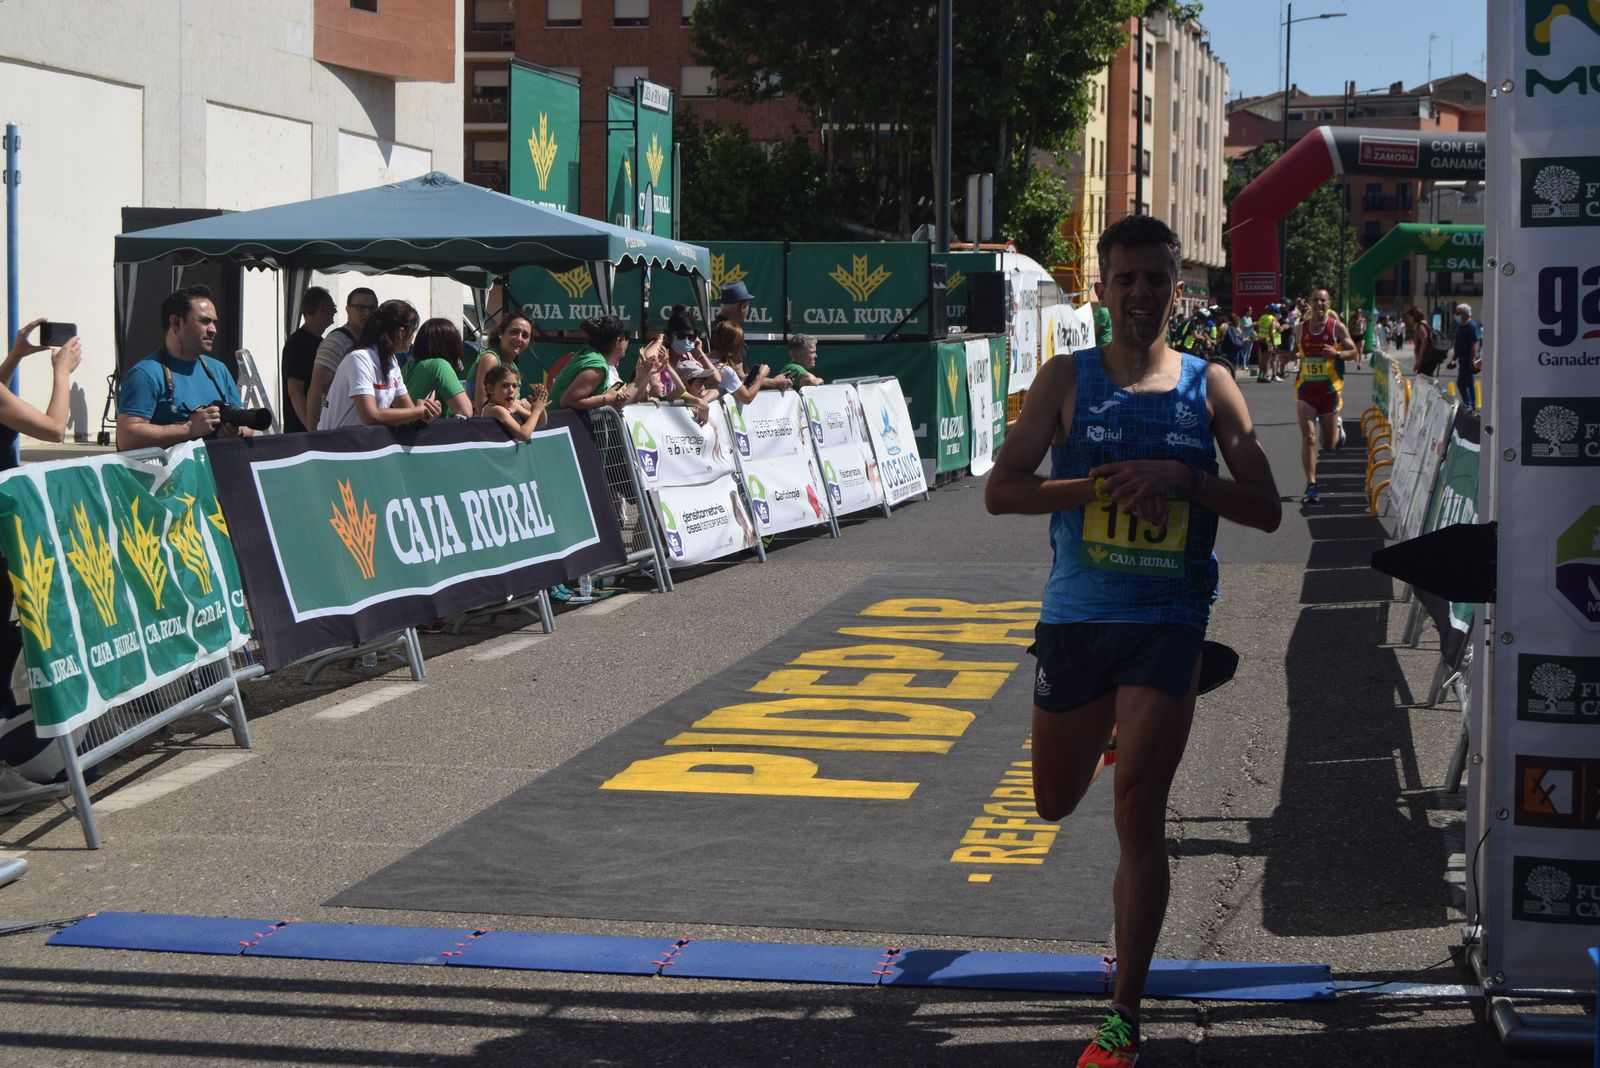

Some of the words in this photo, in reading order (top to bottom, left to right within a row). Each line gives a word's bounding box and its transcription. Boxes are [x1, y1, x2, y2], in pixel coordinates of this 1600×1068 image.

[1431, 141, 1461, 153] CON
[1465, 143, 1480, 153] EL
[1373, 152, 1415, 163] ZAMORA
[522, 303, 564, 320] CAJA
[711, 306, 772, 323] RAL
[803, 308, 849, 324] CAJA
[854, 308, 918, 325] RURAL
[1305, 364, 1323, 375] 151
[881, 452, 922, 490] OCEANIC
[386, 494, 467, 566] CAJA
[460, 480, 554, 551] RURAL
[1109, 552, 1137, 566] CAJA
[1139, 555, 1178, 569] RURAL
[90, 641, 114, 668] CAJA
[113, 630, 141, 661] RURAL
